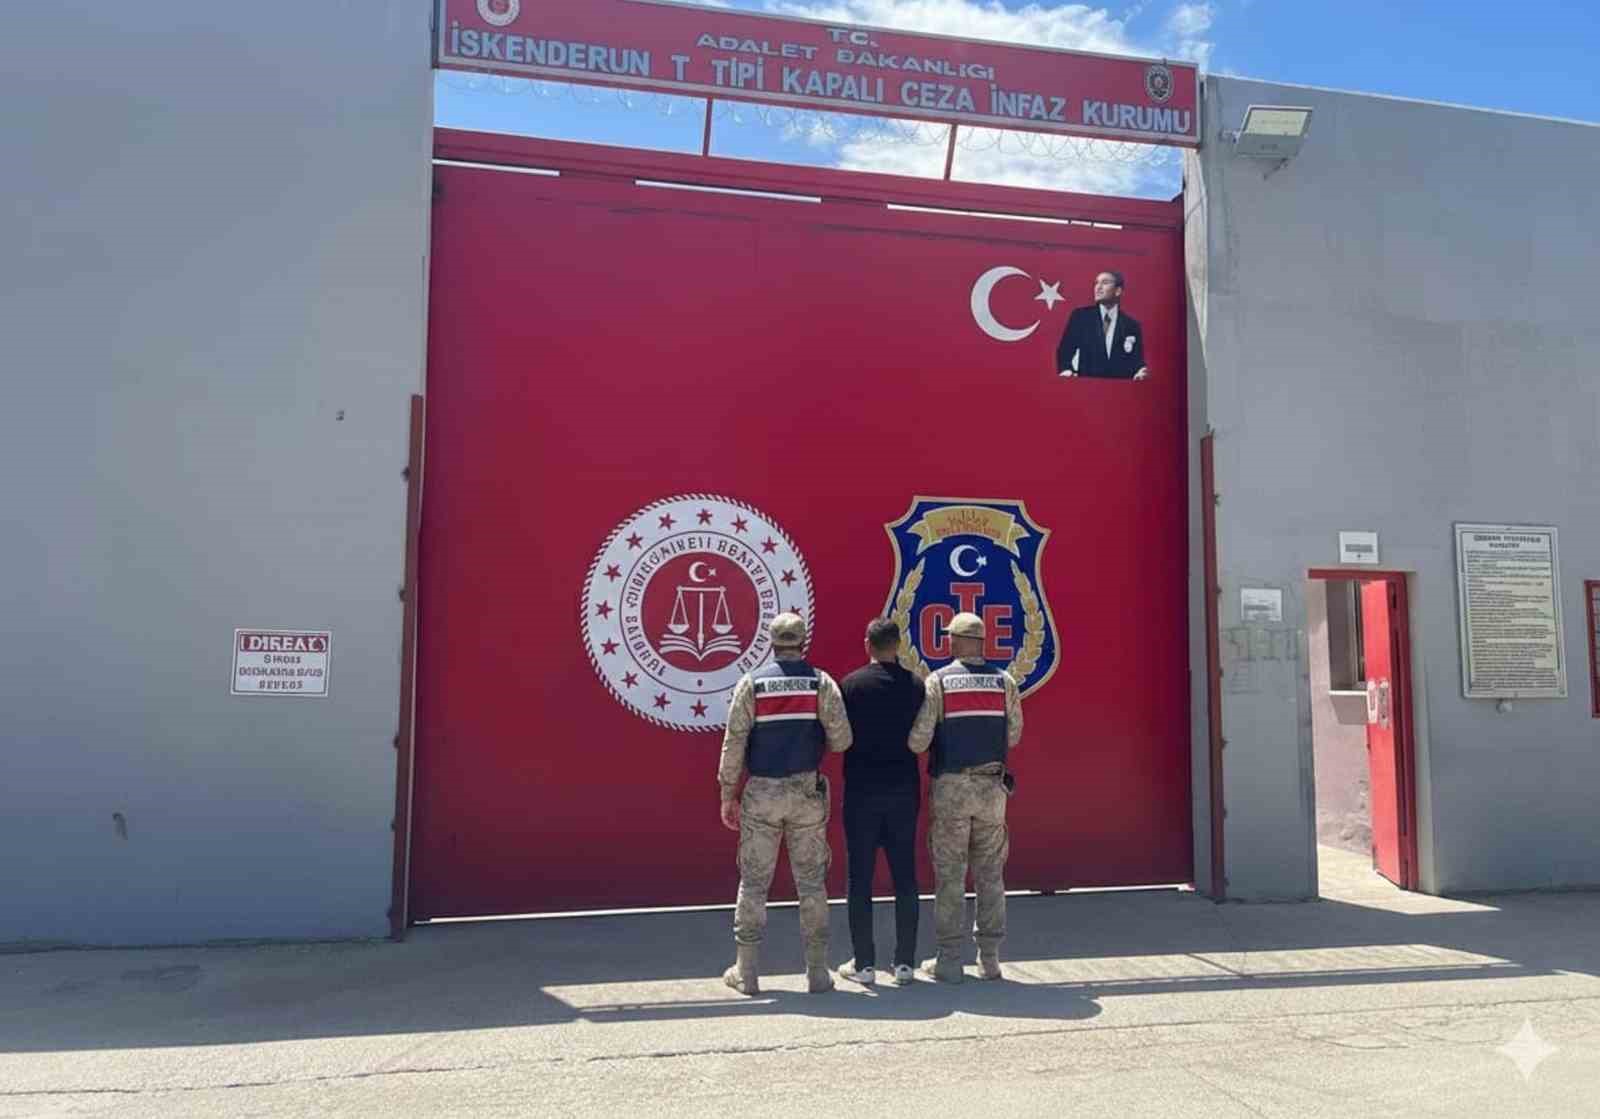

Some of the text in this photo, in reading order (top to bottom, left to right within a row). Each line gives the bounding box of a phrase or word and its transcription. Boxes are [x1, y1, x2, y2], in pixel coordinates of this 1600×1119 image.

[451, 21, 1191, 134] İSKENDERUN T TİPİ KAPALI CEZA İNFAZ KURUMU
[696, 33, 818, 60] ADALET
